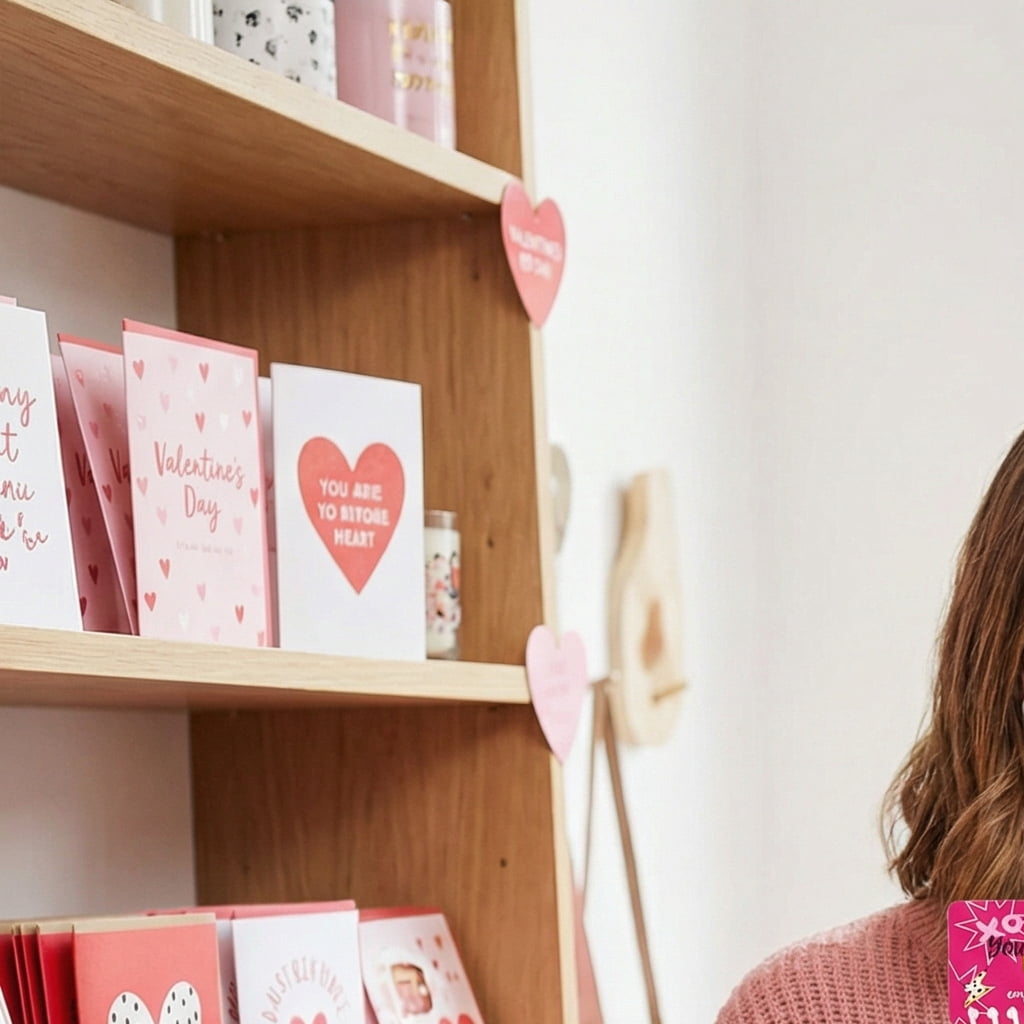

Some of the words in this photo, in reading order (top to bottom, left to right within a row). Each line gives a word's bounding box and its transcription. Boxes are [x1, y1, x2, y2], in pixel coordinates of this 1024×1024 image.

[154, 441, 245, 490] Valentine's
[319, 478, 349, 498] YOU
[184, 485, 221, 533] Day
[317, 502, 337, 520] YO
[333, 528, 376, 549] HEART
